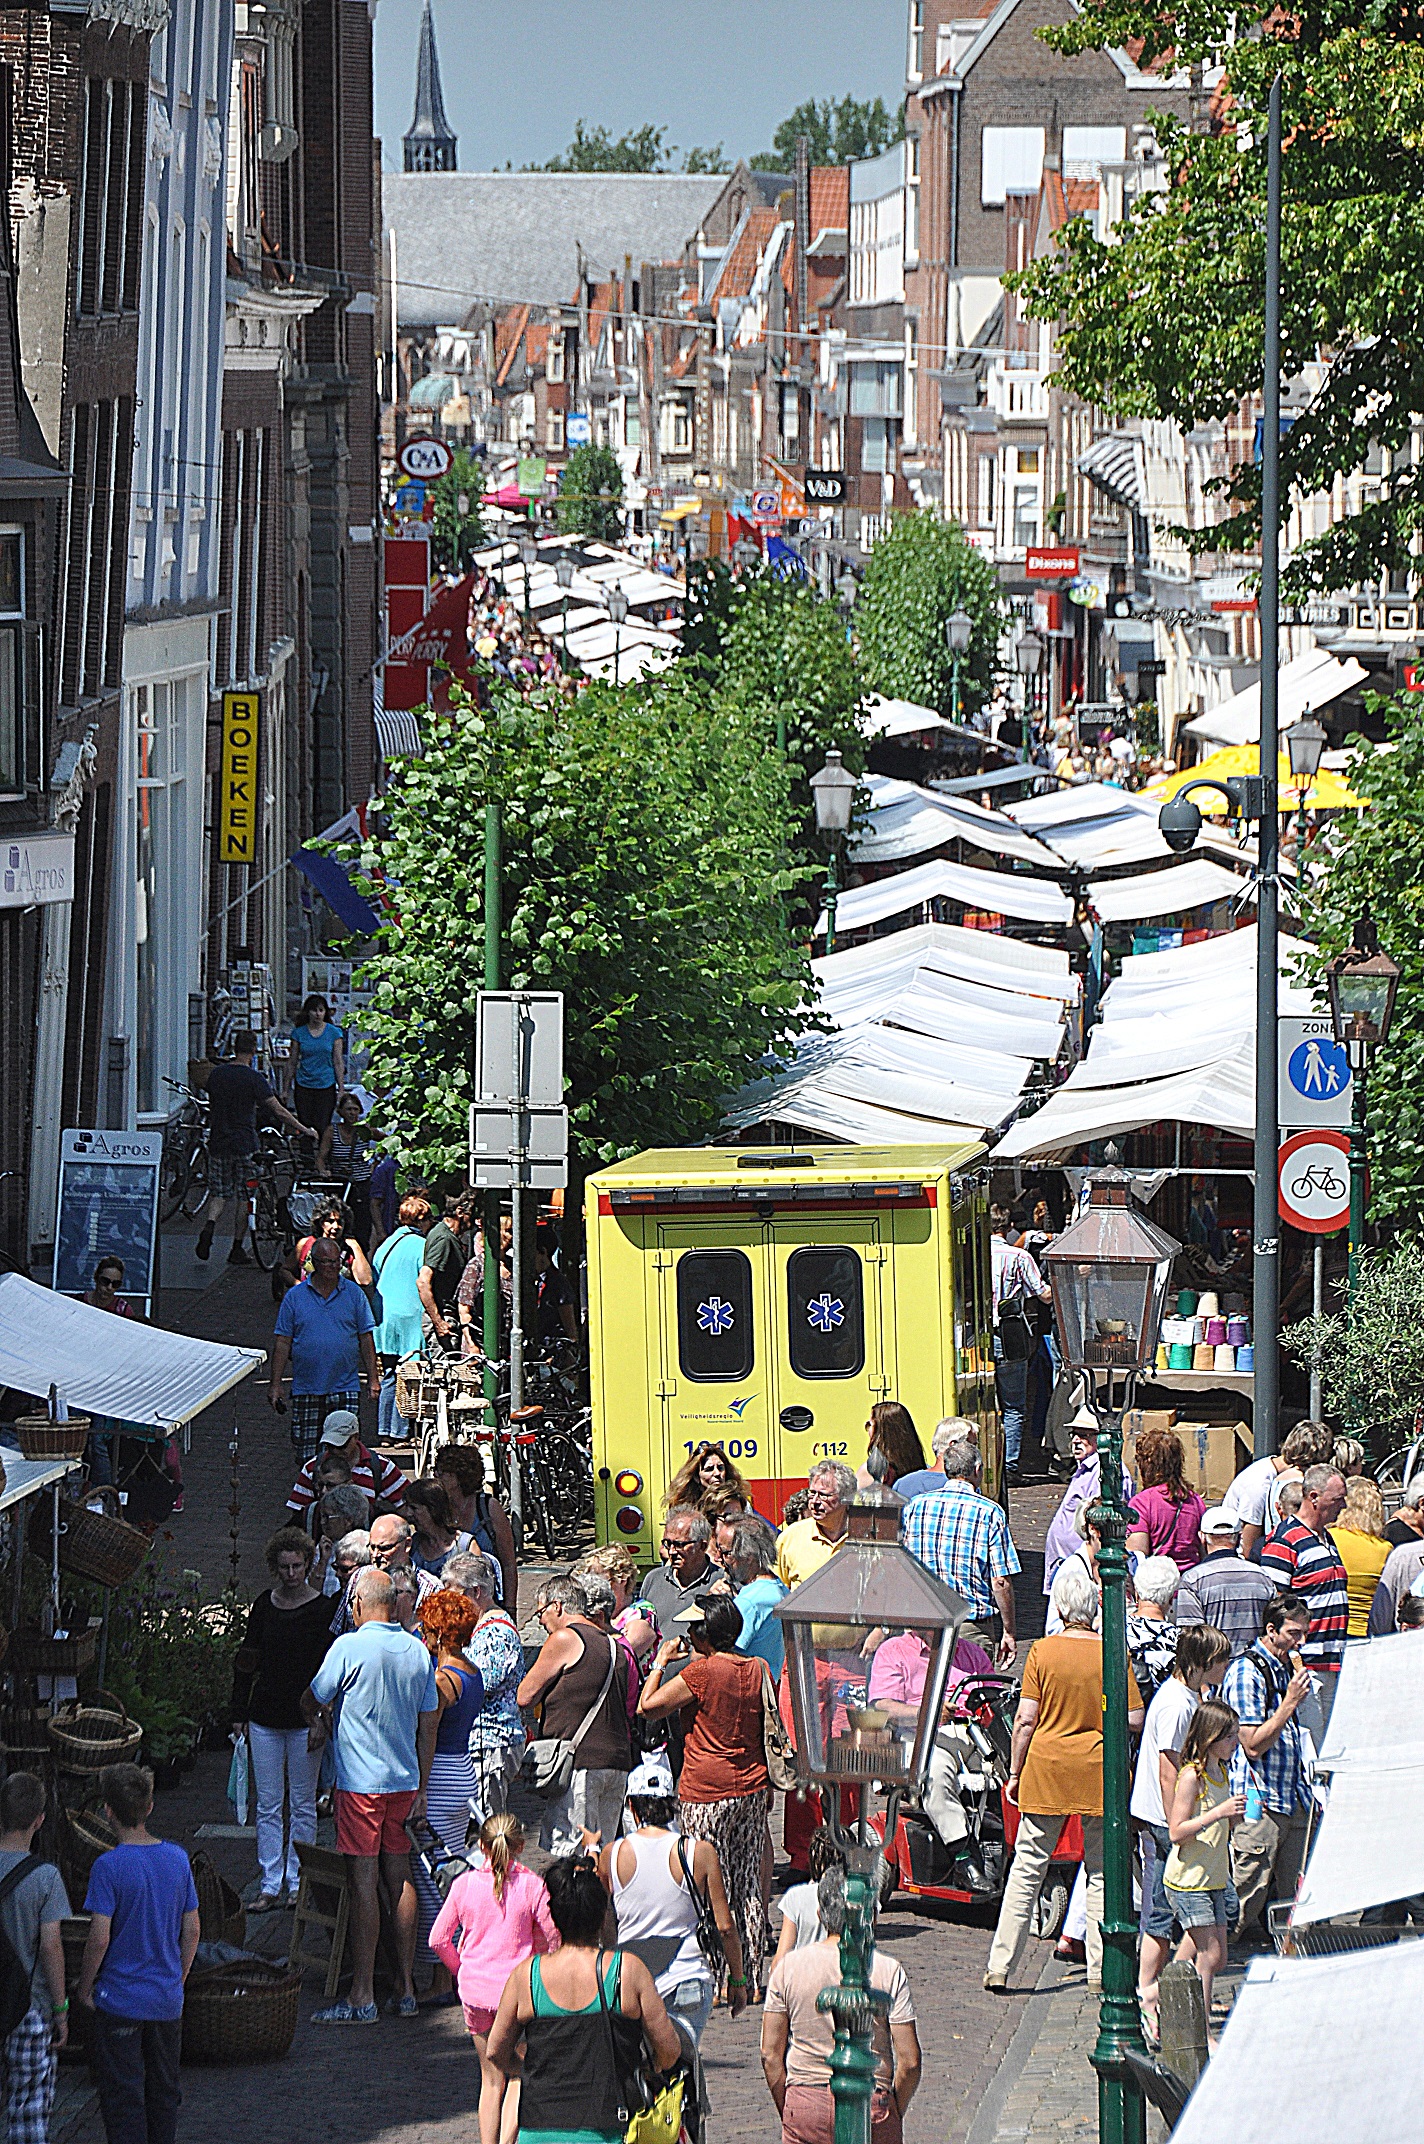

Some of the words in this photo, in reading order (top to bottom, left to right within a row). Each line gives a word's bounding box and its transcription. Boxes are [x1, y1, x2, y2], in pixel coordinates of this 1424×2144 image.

[406, 448, 442, 468] C&A
[806, 479, 842, 498] V&D
[1028, 556, 1077, 570] Dixons
[1299, 604, 1341, 623] VRIES
[227, 701, 252, 854] BOEKEN
[16, 848, 65, 901] Agros
[89, 1134, 151, 1160] Agros
